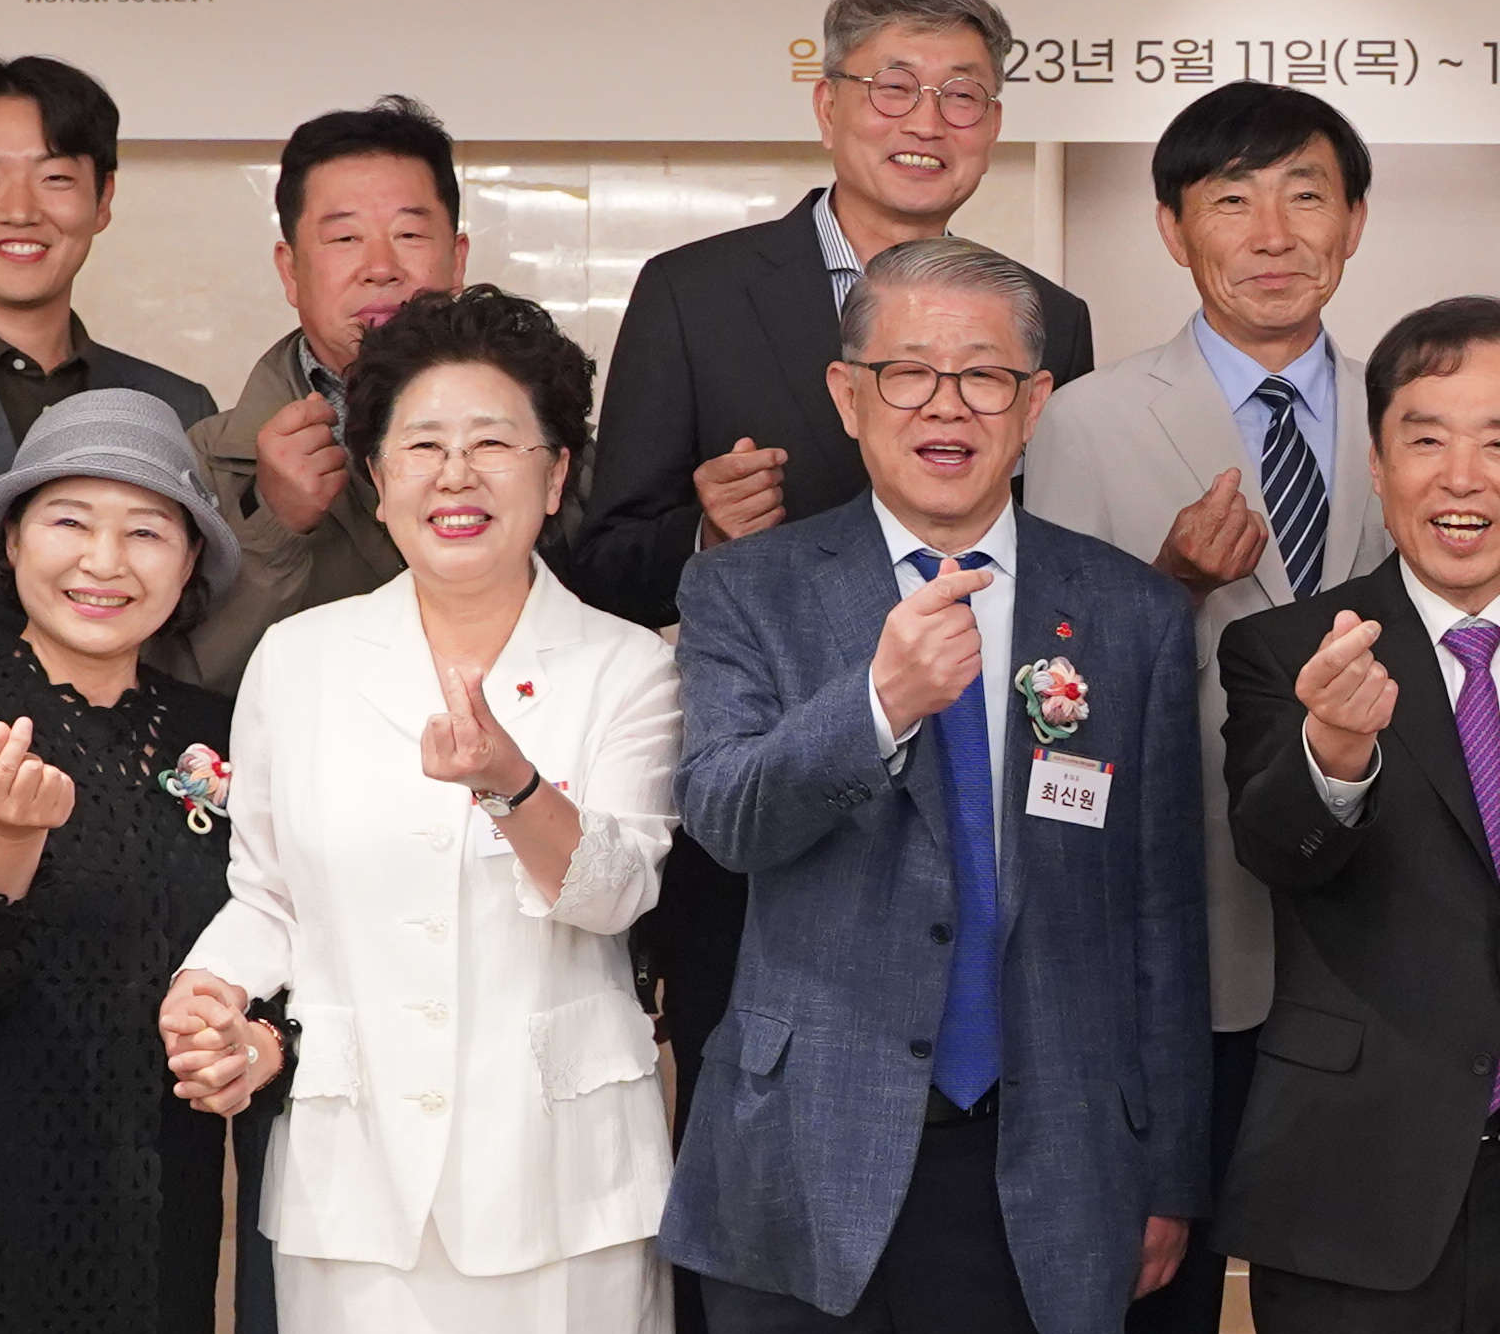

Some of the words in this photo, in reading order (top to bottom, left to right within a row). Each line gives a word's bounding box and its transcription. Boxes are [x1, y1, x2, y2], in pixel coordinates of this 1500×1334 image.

[788, 38, 825, 83] 일
[1004, 38, 1115, 84] 23년
[1135, 39, 1215, 84] 5월
[1236, 39, 1419, 86] 11일(목)
[1041, 782, 1096, 811] 최신원
